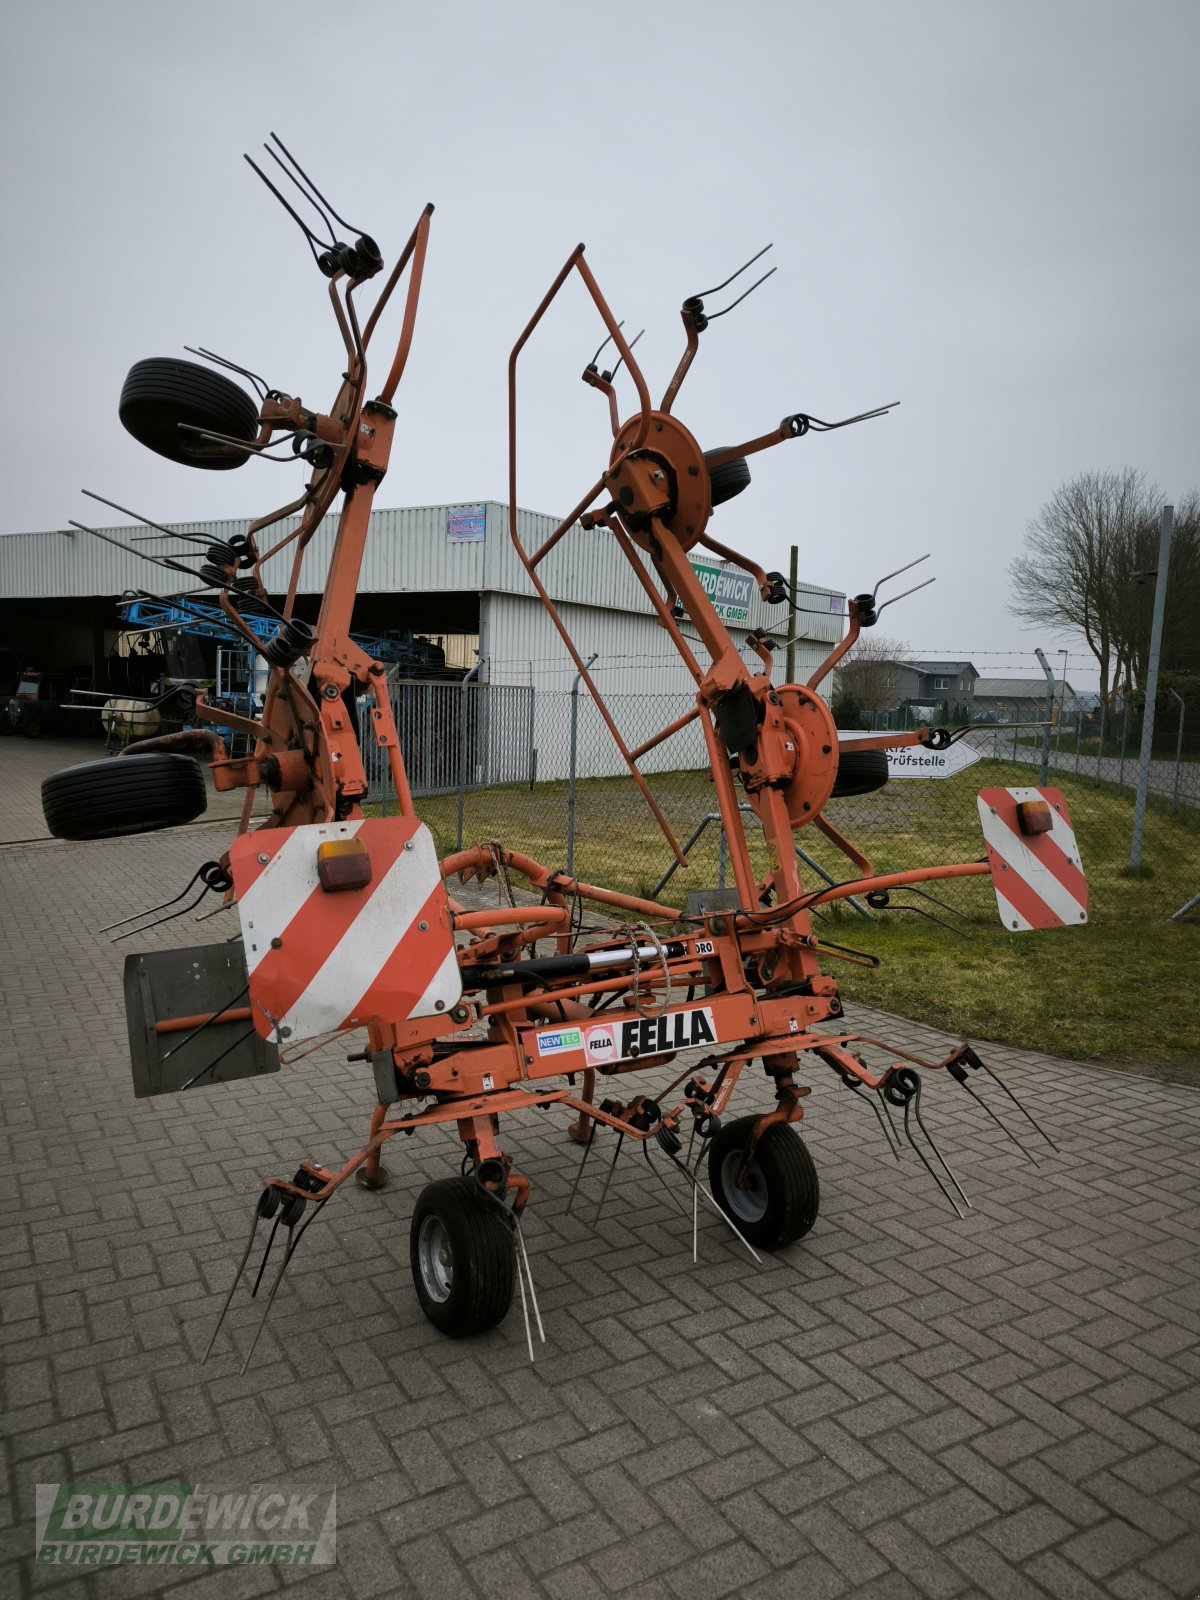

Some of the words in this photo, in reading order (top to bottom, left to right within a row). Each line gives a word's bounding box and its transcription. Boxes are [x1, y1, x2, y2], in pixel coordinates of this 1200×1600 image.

[695, 570, 751, 602] RDEWICK
[726, 606, 749, 621] GMBH
[886, 755, 946, 767] Prüfstelle
[622, 1009, 715, 1058] FELLA
[540, 1034, 579, 1048] NEWTEC
[589, 1038, 613, 1050] FELLA
